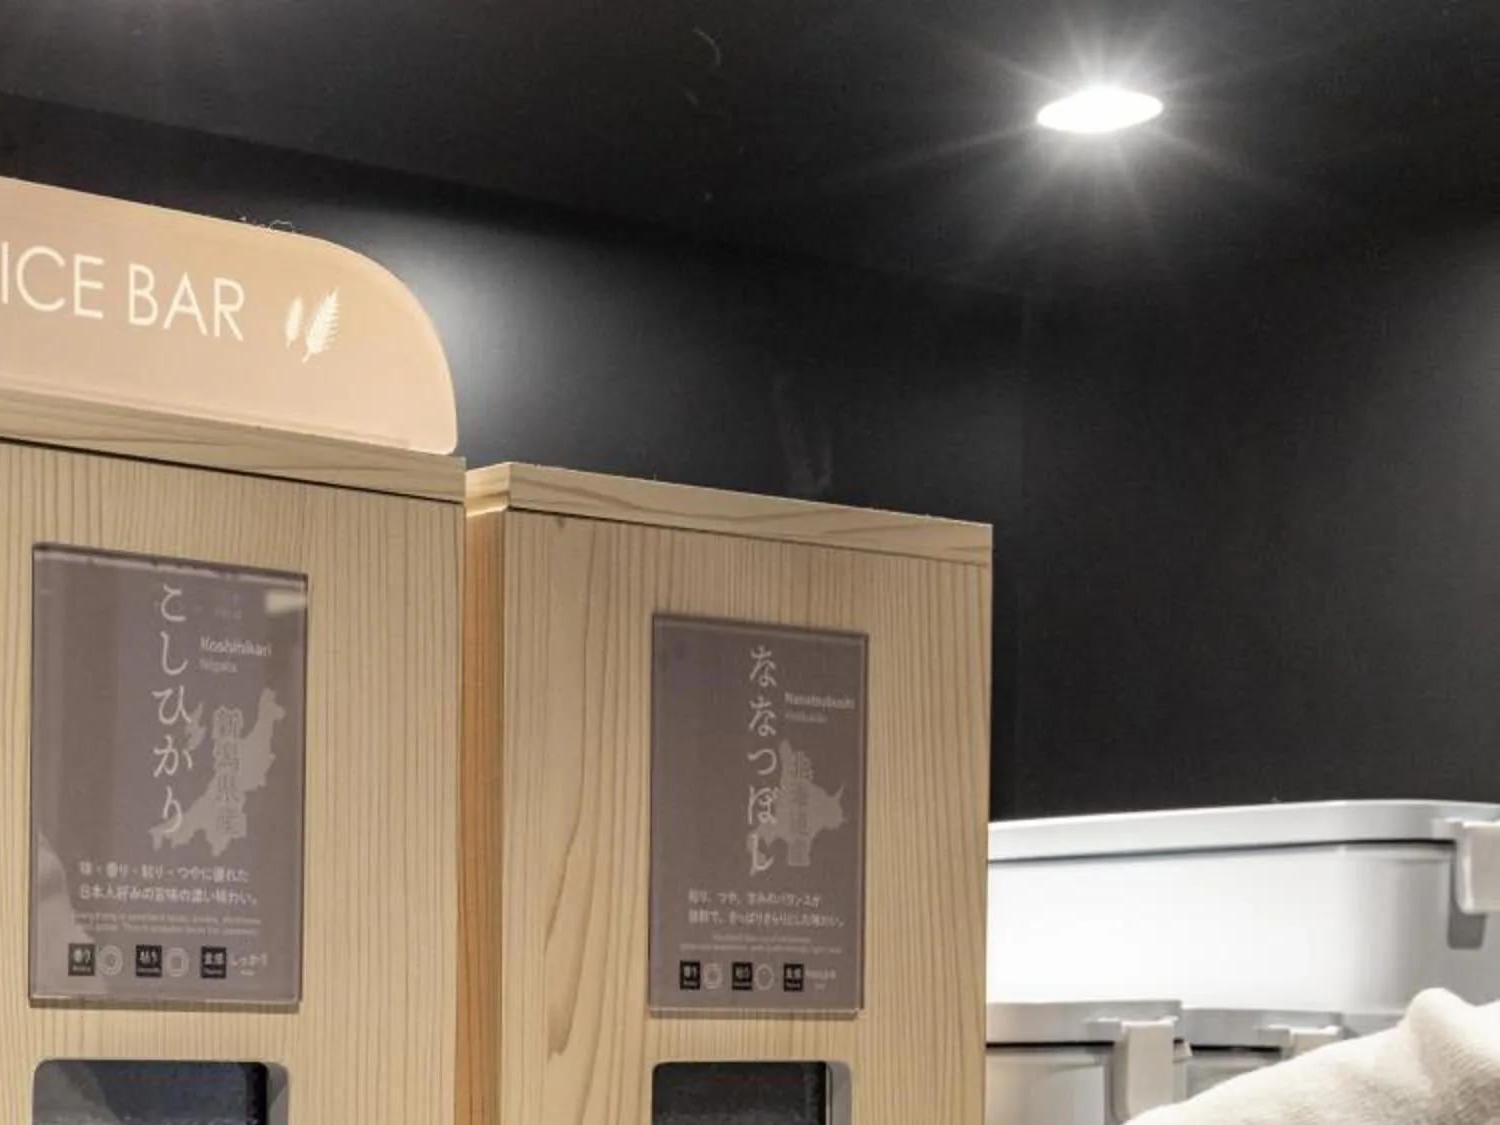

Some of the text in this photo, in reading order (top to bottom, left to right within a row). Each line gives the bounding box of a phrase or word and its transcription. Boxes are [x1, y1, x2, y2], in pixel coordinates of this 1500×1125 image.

[128, 263, 245, 342] BAR
[151, 583, 194, 834] こしひかり
[747, 645, 779, 872] ななつぼし
